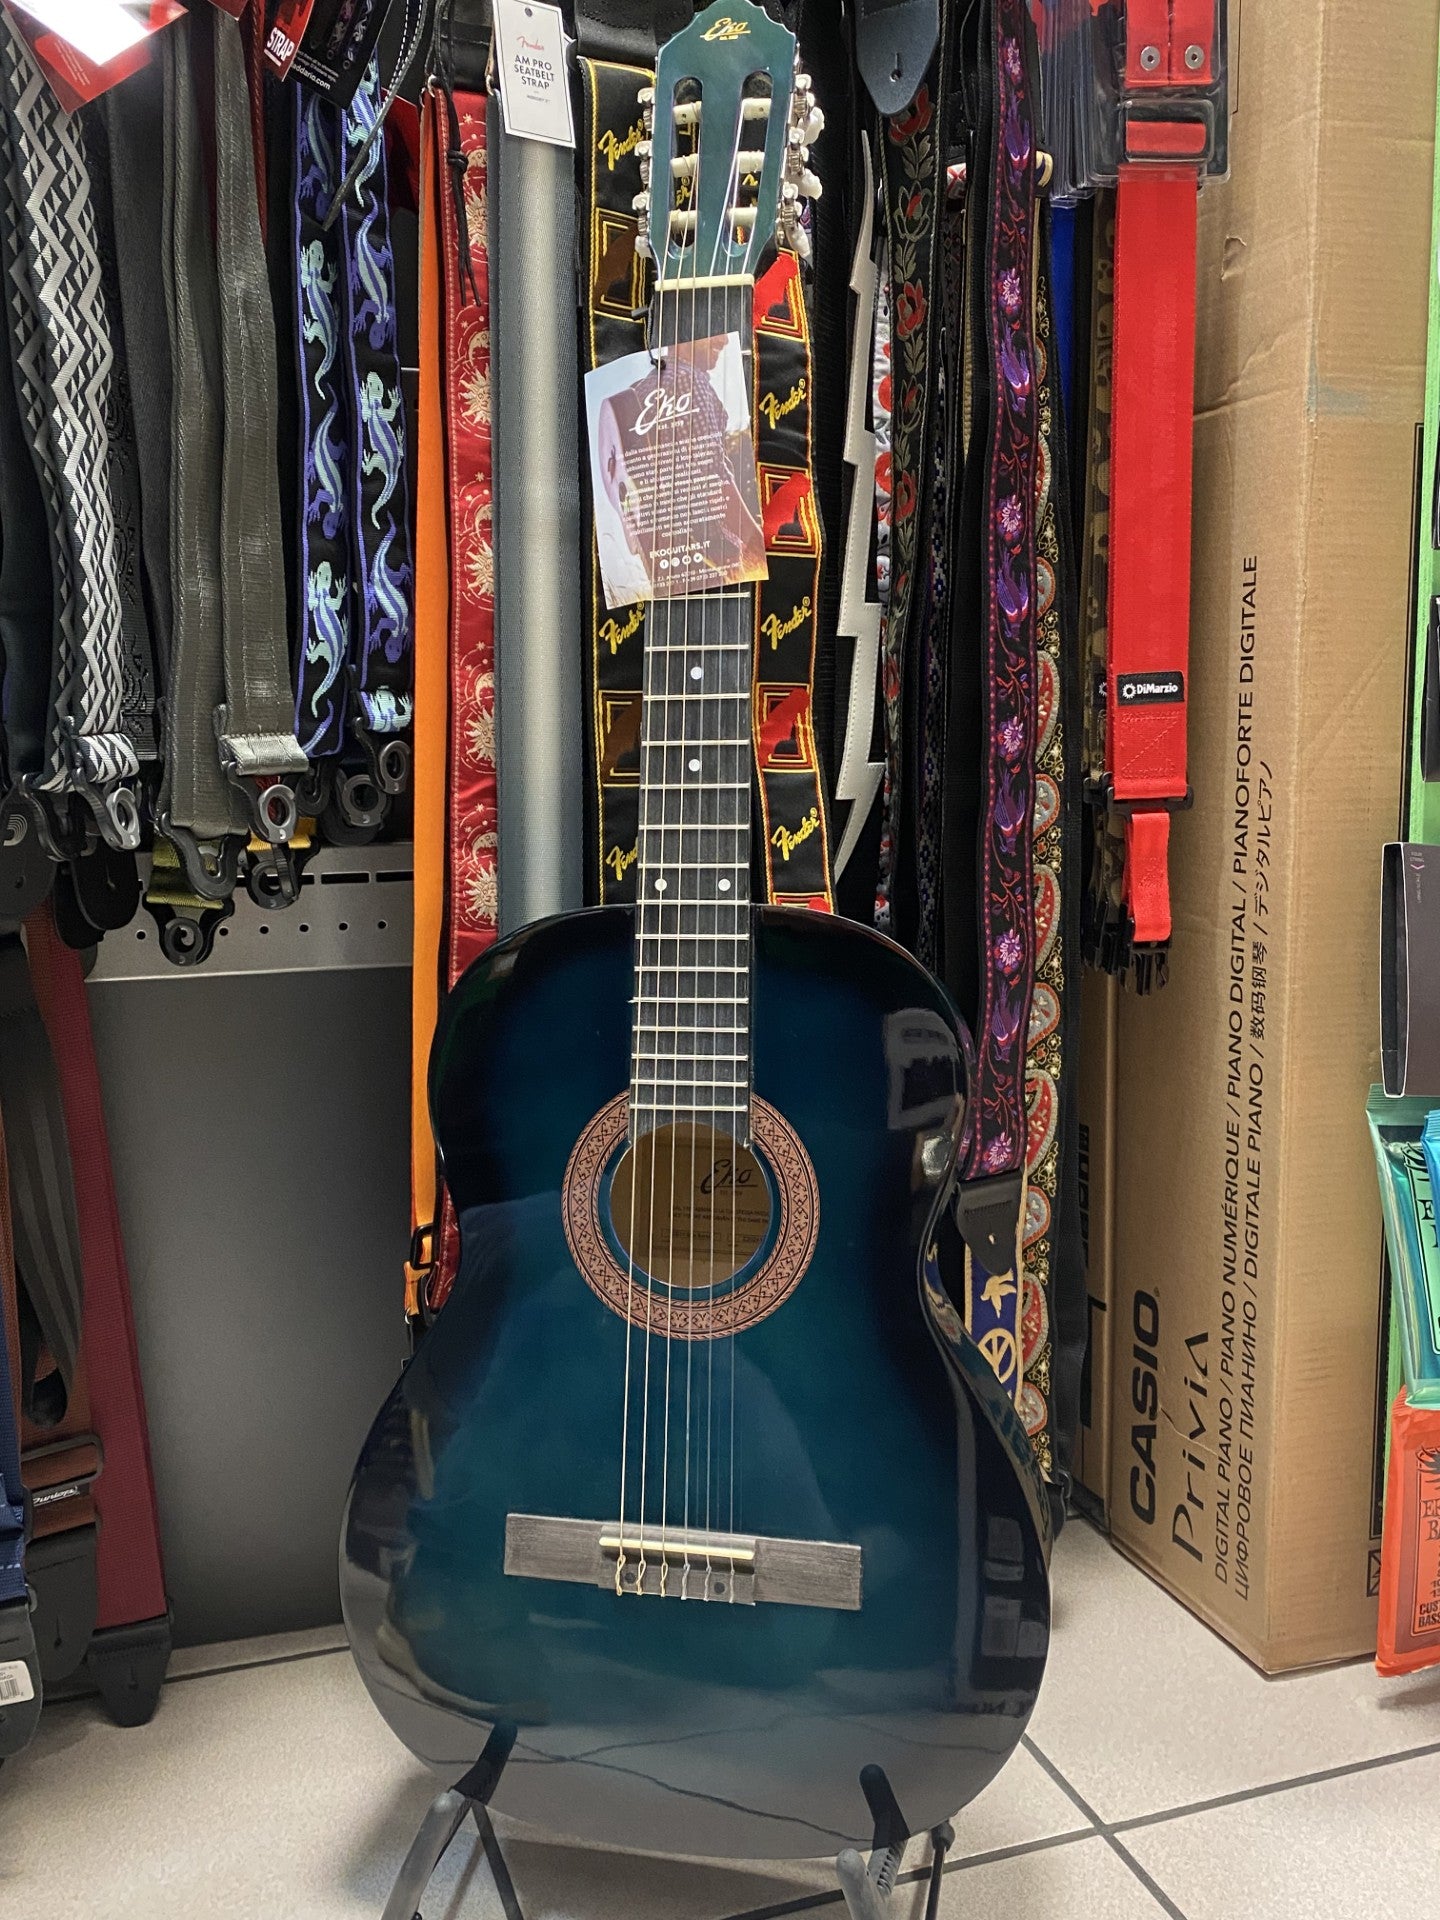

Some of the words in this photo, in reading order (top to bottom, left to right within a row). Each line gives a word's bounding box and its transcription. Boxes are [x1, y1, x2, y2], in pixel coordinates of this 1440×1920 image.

[266, 27, 295, 62] STRAP
[514, 64, 555, 82] SEATBELT
[515, 54, 530, 66] AM
[533, 59, 553, 71] PRO
[516, 35, 545, 51] Fender
[700, 17, 751, 41] Eko
[521, 76, 550, 90] STRAP
[628, 388, 700, 436] Eko
[1240, 556, 1257, 683] DIGITALE
[1136, 682, 1179, 696] DiMarzio
[1233, 692, 1253, 874] PIANOFORTE
[605, 836, 639, 881] Fend
[1254, 761, 1272, 916] デジタルピアノ
[1230, 899, 1246, 1003] DIGITAL
[1250, 941, 1267, 1040] 数码钢琴
[1227, 1010, 1242, 1099] PIANO
[1248, 1063, 1263, 1152] PIANO
[700, 1158, 758, 1195] Eko
[1223, 1120, 1239, 1286] NUMÉRIQUE
[1244, 1157, 1260, 1279] DIGITALE
[1221, 1291, 1235, 1377] PIANO
[1240, 1301, 1256, 1440] ПИАНИНО
[1130, 1288, 1158, 1525] CASIO
[1218, 1398, 1232, 1482] PIANO
[1215, 1488, 1230, 1584] DIGITAL
[1235, 1443, 1252, 1600] ЦИФРОВОЕ
